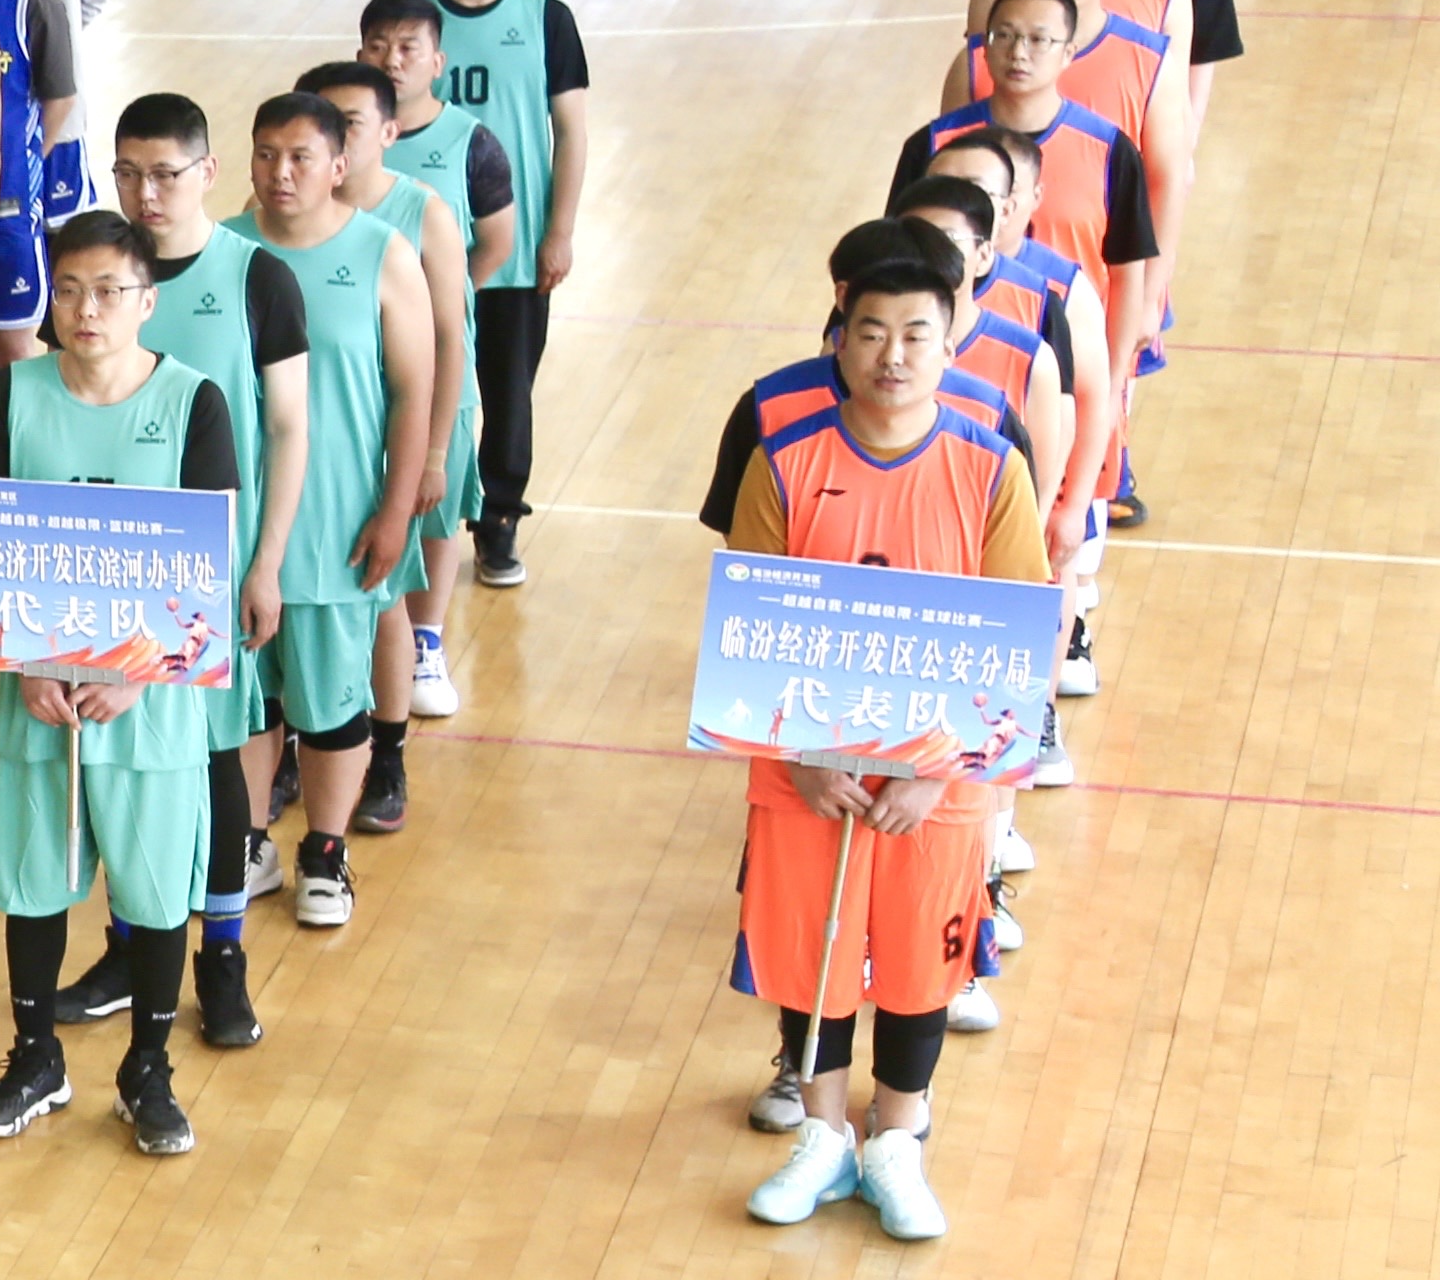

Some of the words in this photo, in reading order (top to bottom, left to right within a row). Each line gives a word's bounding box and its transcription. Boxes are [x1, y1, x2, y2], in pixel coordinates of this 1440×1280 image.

[449, 65, 489, 106] 10
[720, 615, 1033, 693] 临汾经济开发区公安分局
[777, 676, 958, 737] 代表队
